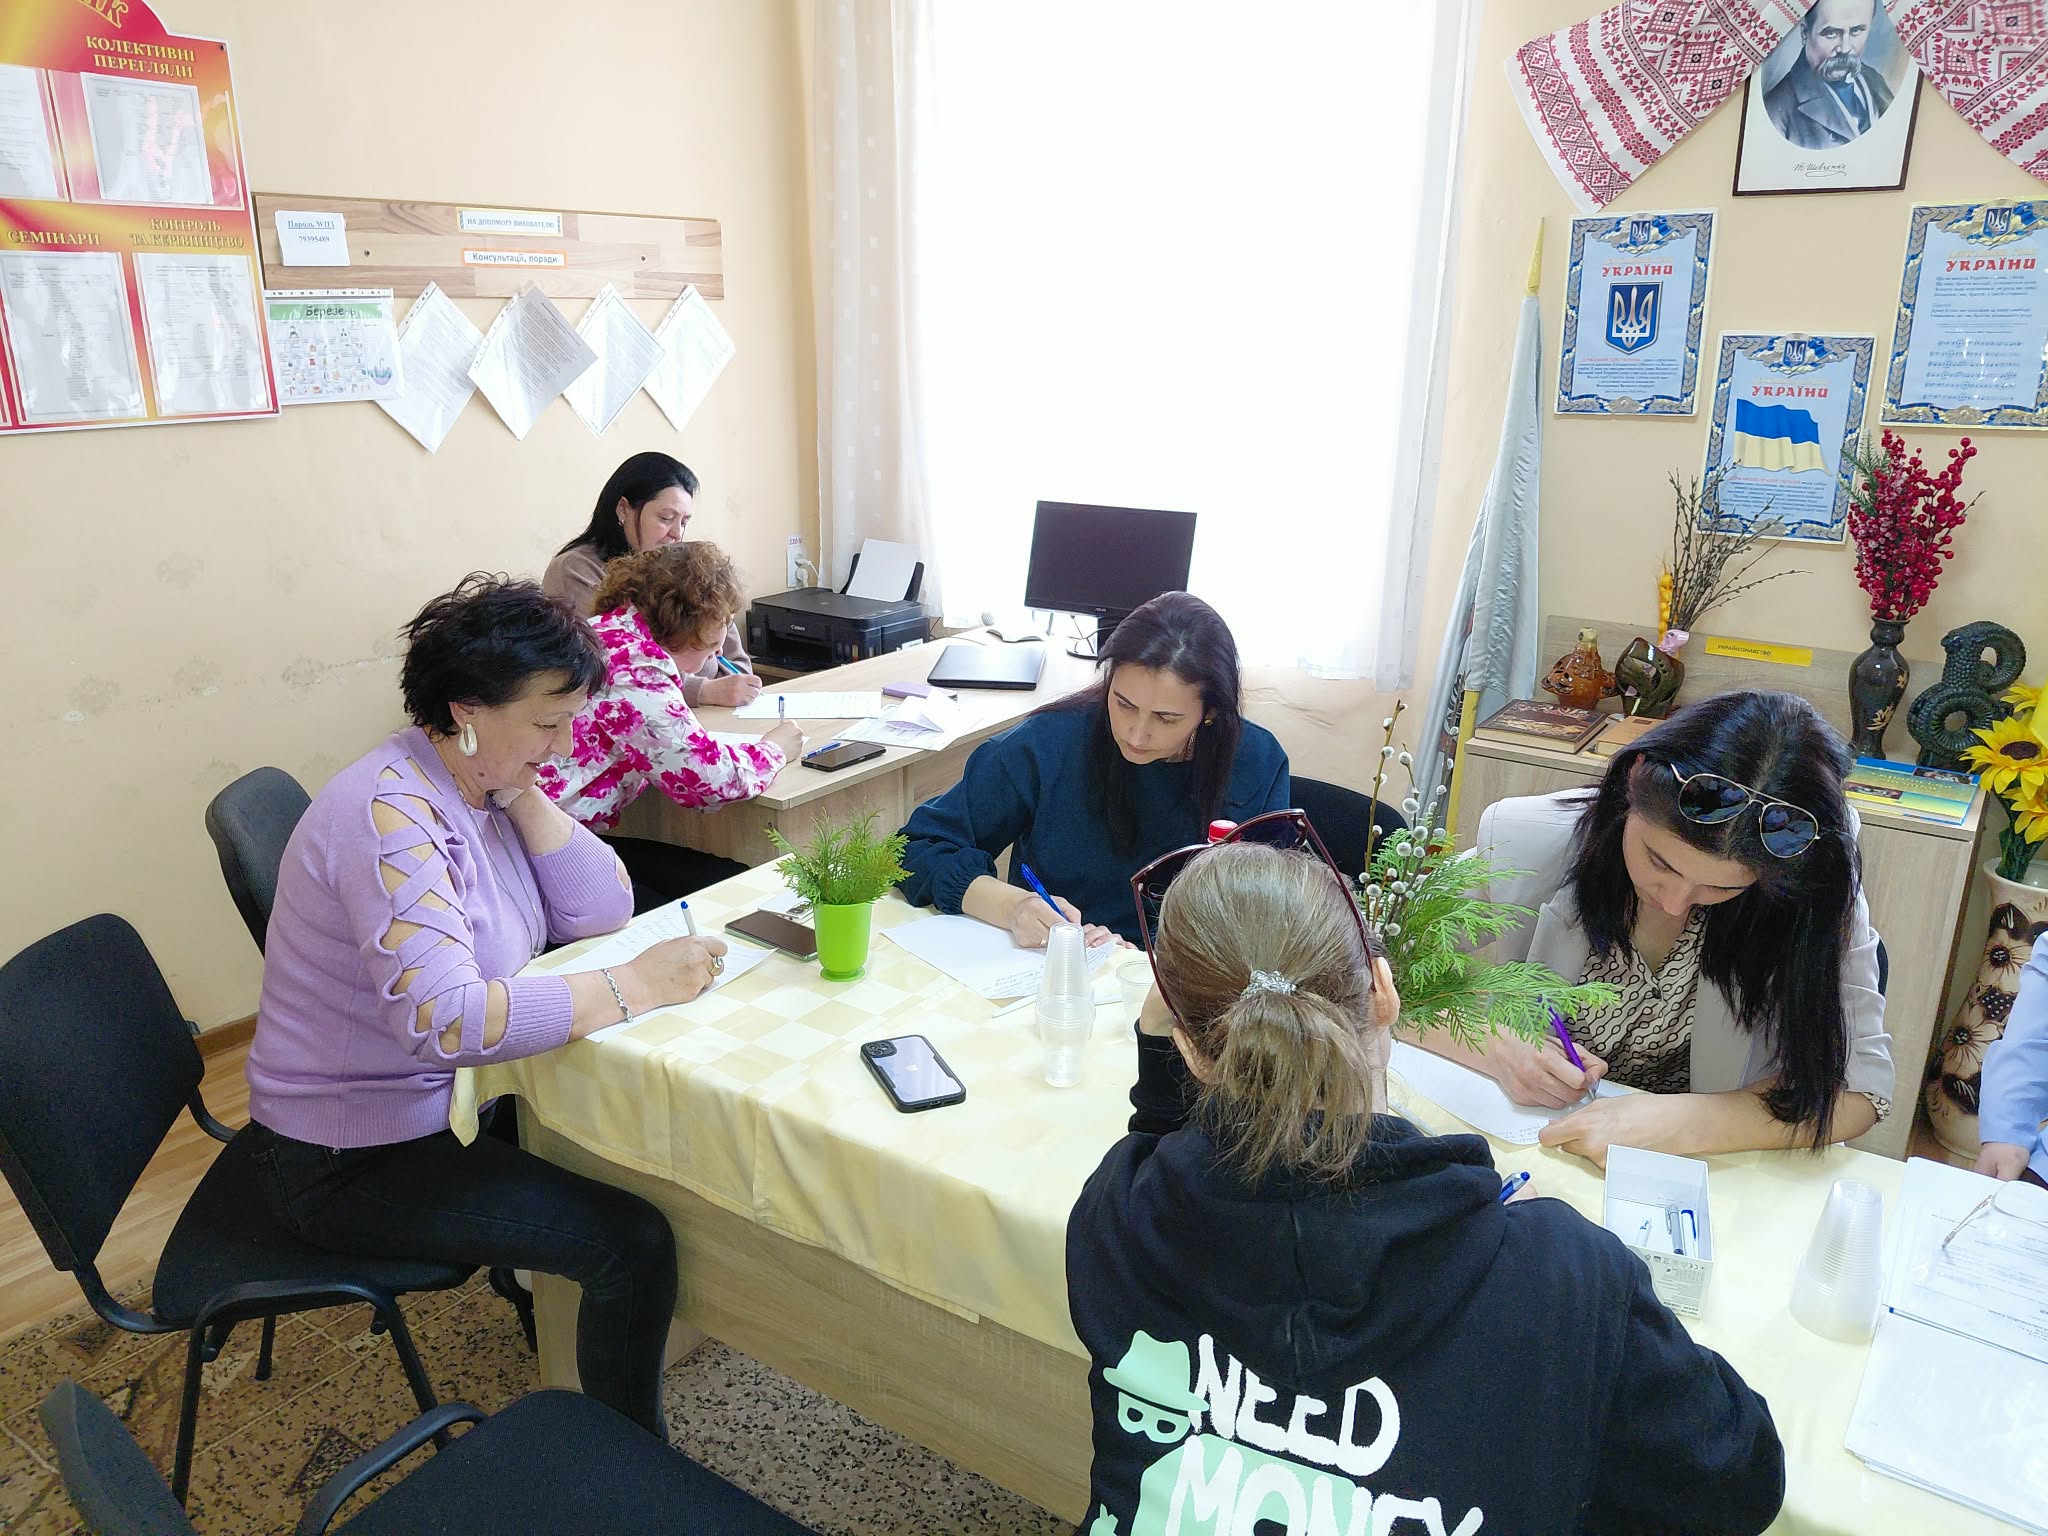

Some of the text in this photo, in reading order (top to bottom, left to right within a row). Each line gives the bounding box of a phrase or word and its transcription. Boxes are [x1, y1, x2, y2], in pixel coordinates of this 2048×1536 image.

[86, 35, 195, 62] КОЛЕКТИВНІ
[94, 54, 193, 78] ПЕРЕГЛЯДИ
[150, 218, 221, 232] КОНТРОЛЬ
[478, 218, 511, 226] ДОПОМОГУ
[7, 230, 101, 245] СЕМІНАРИ
[472, 252, 558, 264] Консультації, поради
[1945, 257, 2036, 272] УКРАЇНИ
[1602, 264, 1673, 278] УКРАЇНИ
[1751, 385, 1829, 398] УКРАЇНИ
[1188, 1333, 1401, 1477] NEED
